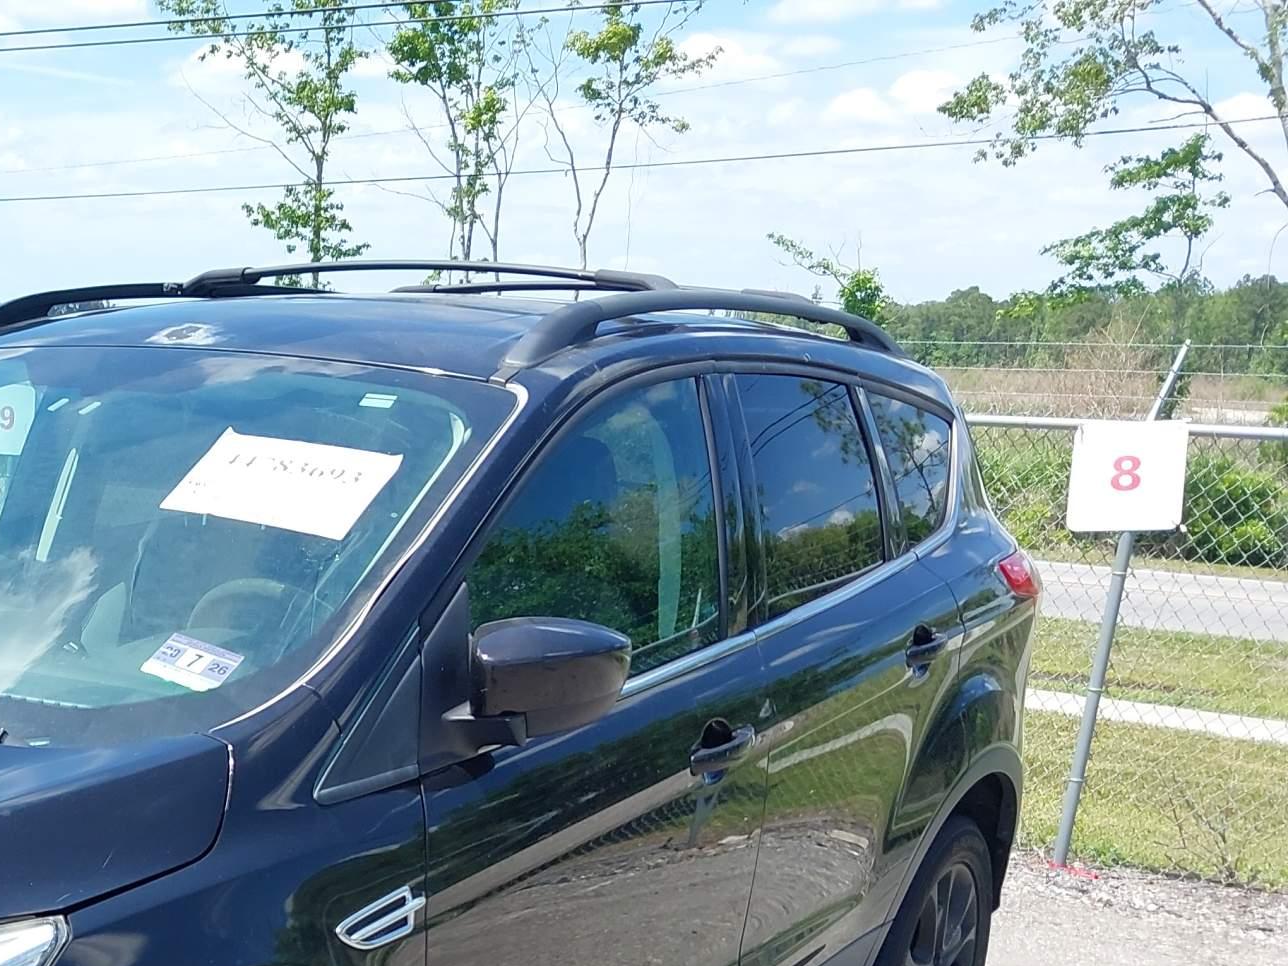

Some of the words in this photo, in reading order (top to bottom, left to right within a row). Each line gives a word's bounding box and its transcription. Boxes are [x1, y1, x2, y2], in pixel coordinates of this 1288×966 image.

[0, 405, 15, 430] 9
[228, 453, 363, 484] 83693
[1110, 455, 1142, 491] 8
[186, 653, 204, 668] 7
[207, 663, 229, 676] 26
